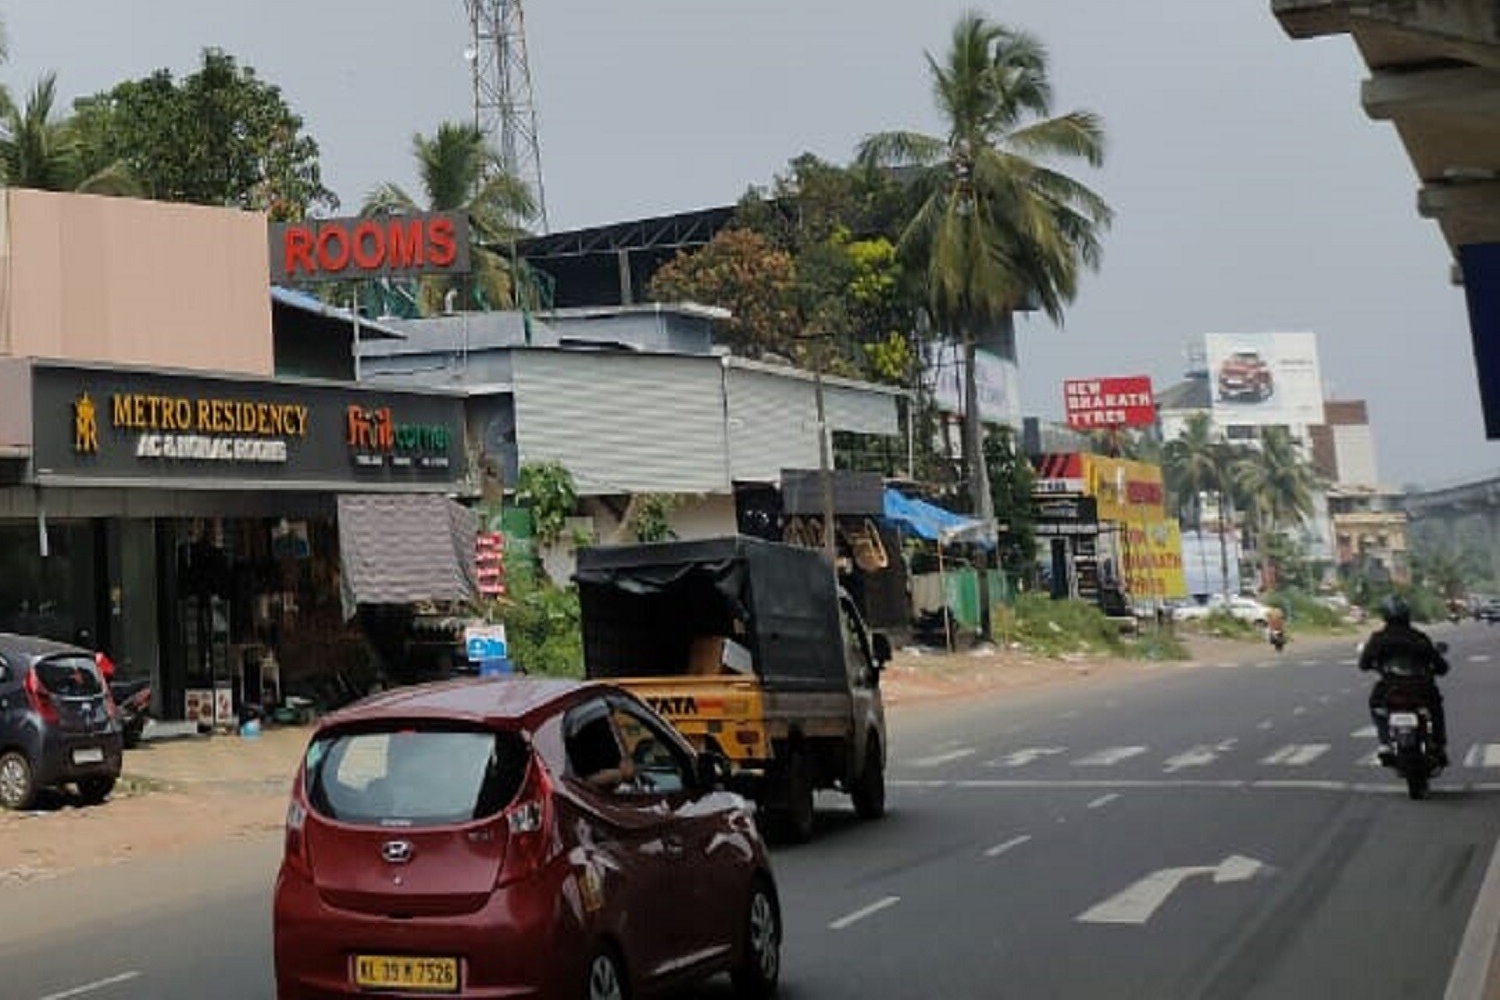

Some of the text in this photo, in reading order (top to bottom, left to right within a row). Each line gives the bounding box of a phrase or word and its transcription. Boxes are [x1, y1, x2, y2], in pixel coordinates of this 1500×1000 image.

[283, 216, 457, 275] ROOMS
[1067, 381, 1100, 395] NEW
[1067, 392, 1151, 410] BHARATH
[113, 393, 308, 437] METRO RESIDENCY
[1069, 409, 1127, 427] TYRES
[645, 696, 698, 714] TATA
